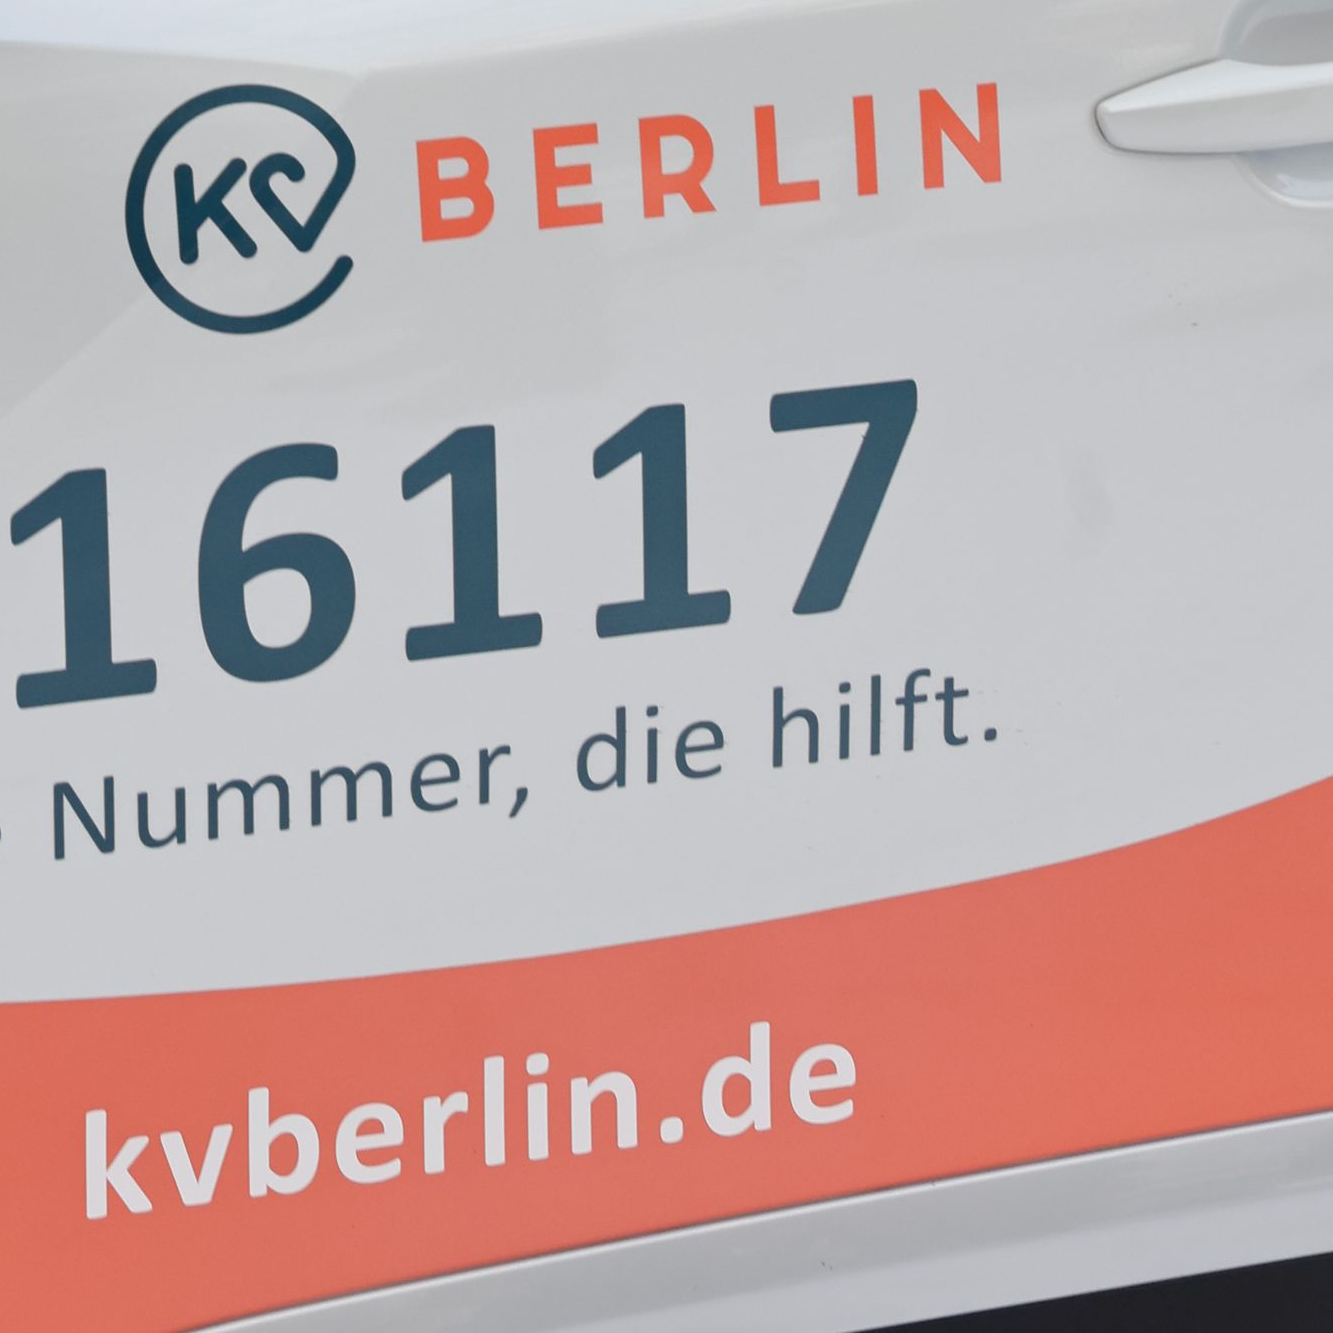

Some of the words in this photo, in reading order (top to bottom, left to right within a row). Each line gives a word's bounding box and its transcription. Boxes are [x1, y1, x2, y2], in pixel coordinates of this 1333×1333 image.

[415, 83, 1003, 243] BERLIN
[53, 745, 530, 862] Nummer,
[576, 705, 726, 793] die
[772, 668, 999, 770] hilft.
[85, 1020, 858, 1222] kvberlin.de
